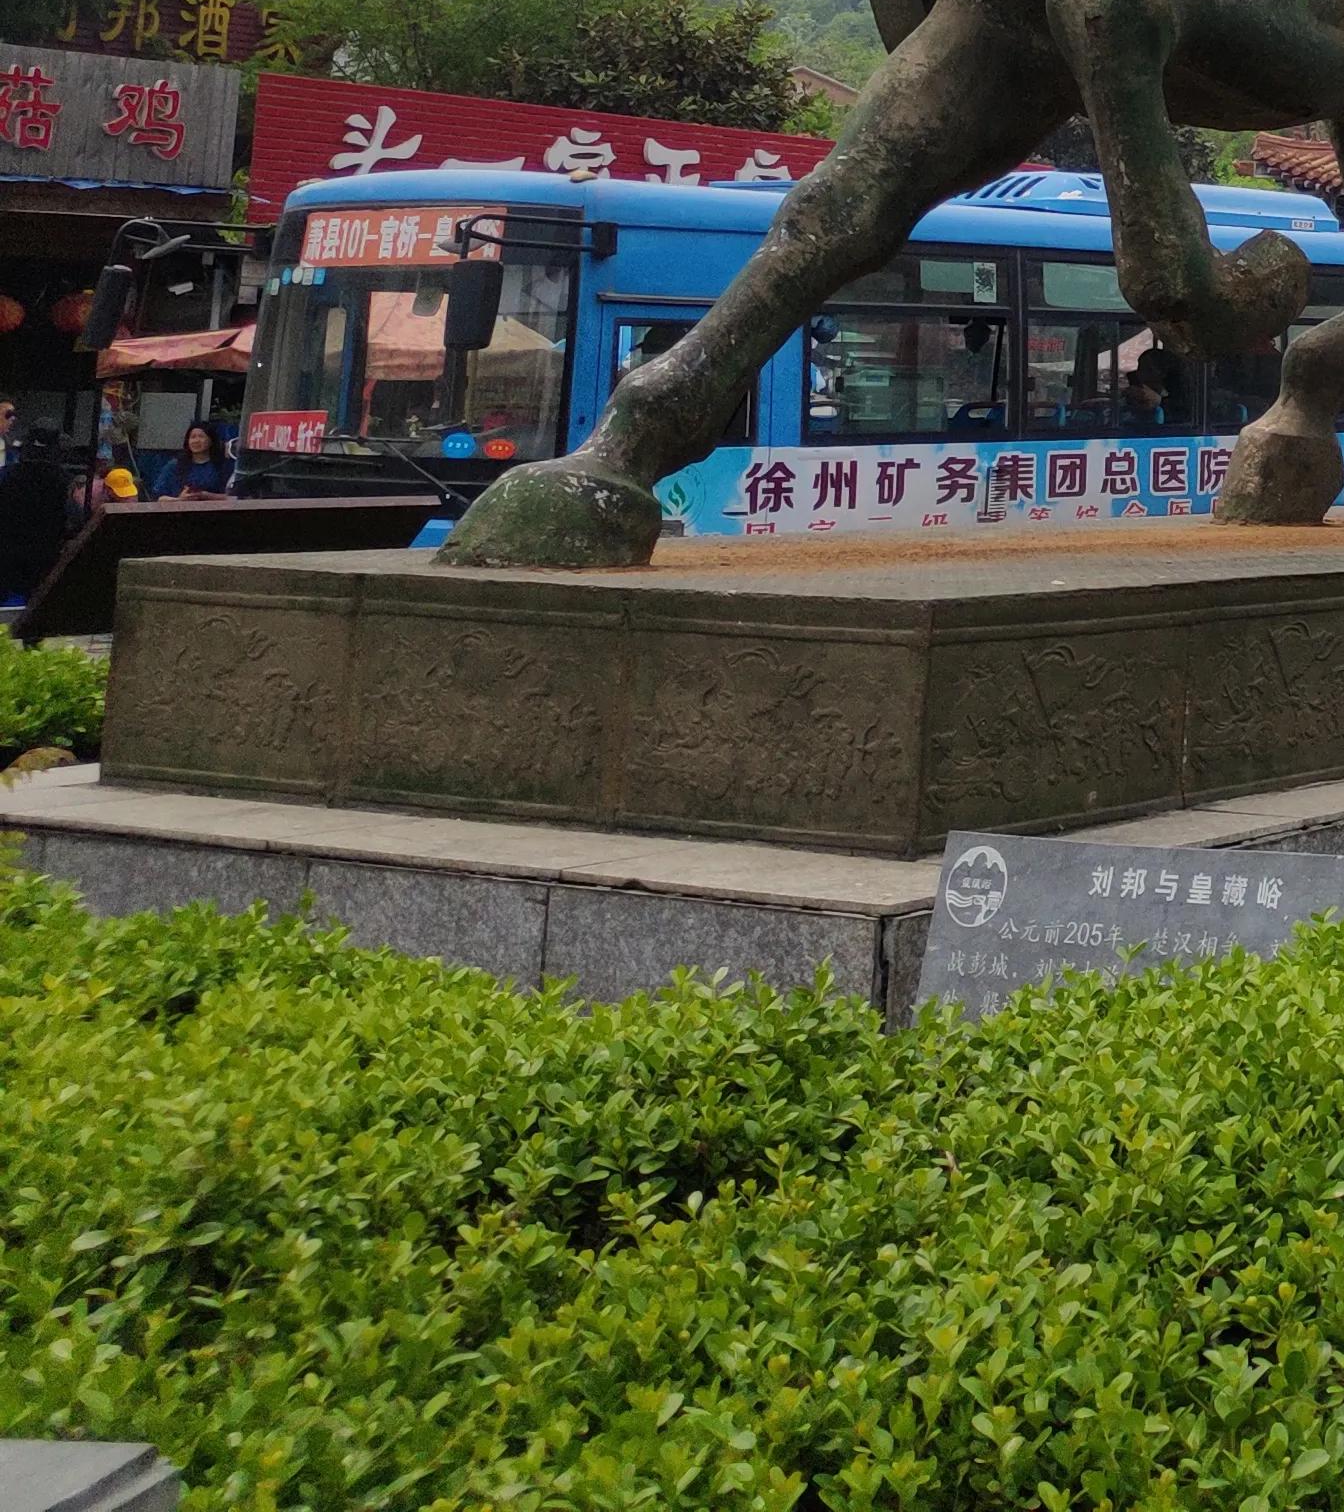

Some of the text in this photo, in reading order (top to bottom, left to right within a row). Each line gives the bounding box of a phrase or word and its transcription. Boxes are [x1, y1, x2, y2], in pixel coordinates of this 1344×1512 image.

[1087, 866, 1284, 910] 刘邦与皇藏峪
